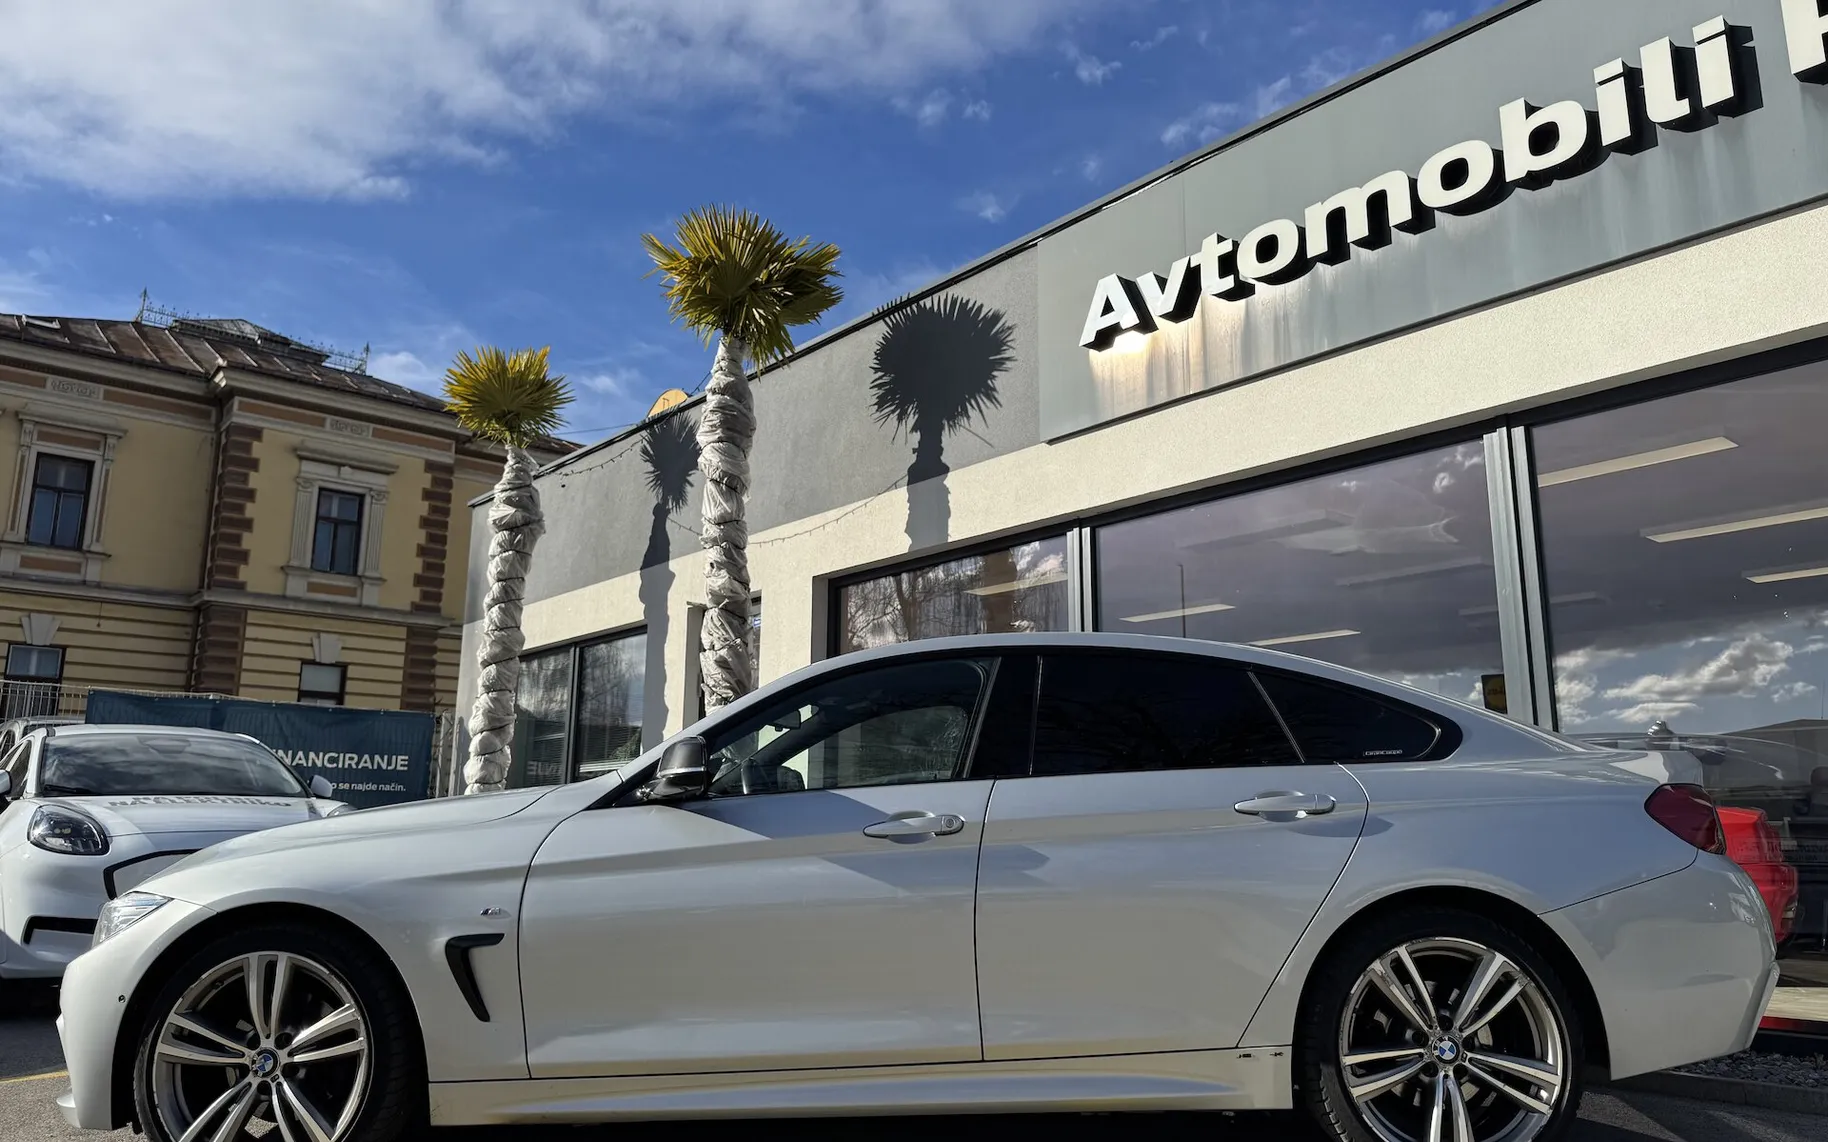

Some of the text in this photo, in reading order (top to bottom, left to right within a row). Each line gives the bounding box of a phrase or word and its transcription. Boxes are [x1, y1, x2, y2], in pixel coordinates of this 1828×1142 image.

[1079, 16, 1735, 347] Avtomobili
[273, 749, 409, 771] NANCIRANJE
[351, 782, 378, 791] najde
[379, 782, 407, 792] način.
